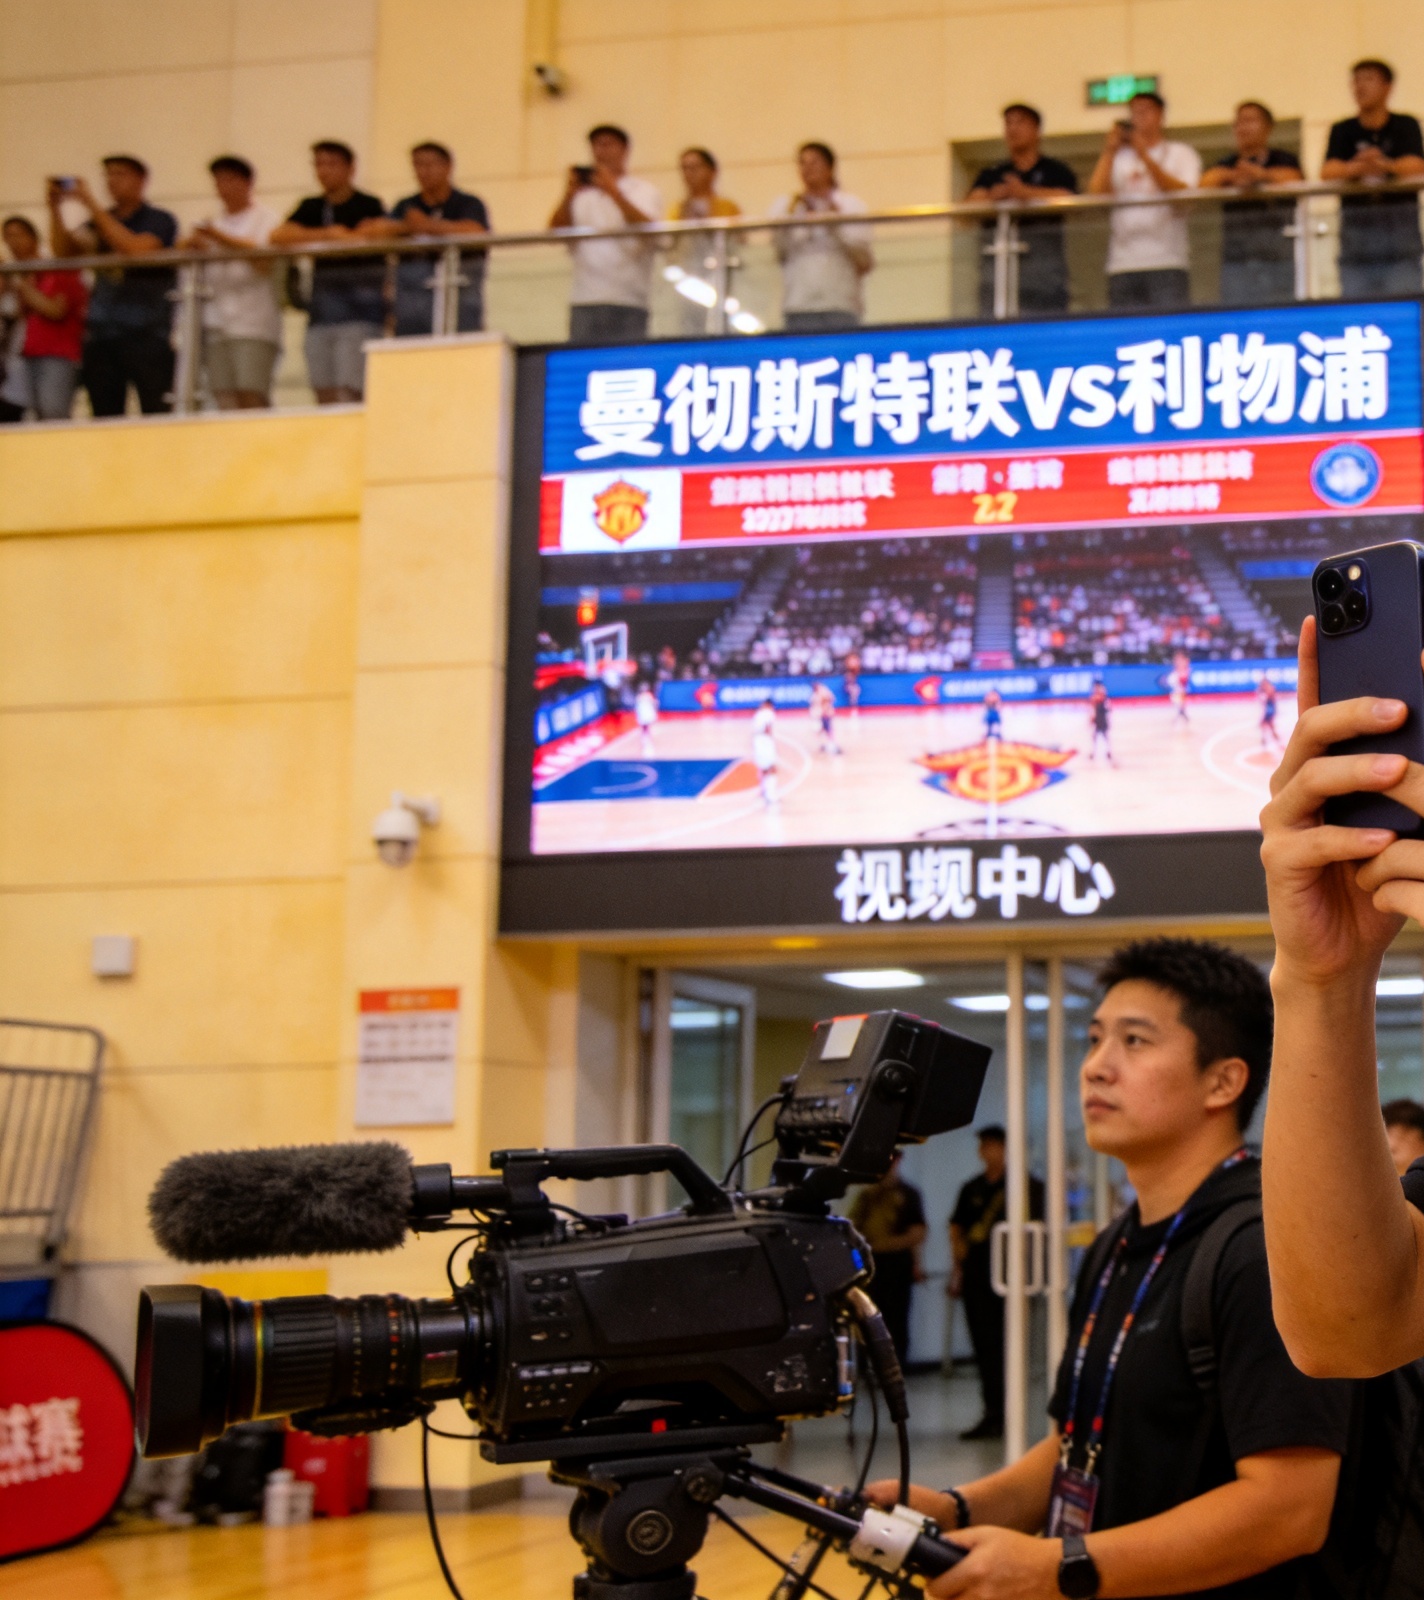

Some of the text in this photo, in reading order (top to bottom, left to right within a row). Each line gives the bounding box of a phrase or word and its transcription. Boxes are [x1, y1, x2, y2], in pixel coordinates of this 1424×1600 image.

[574, 325, 1392, 461] 曼彻斯特联vs利物浦
